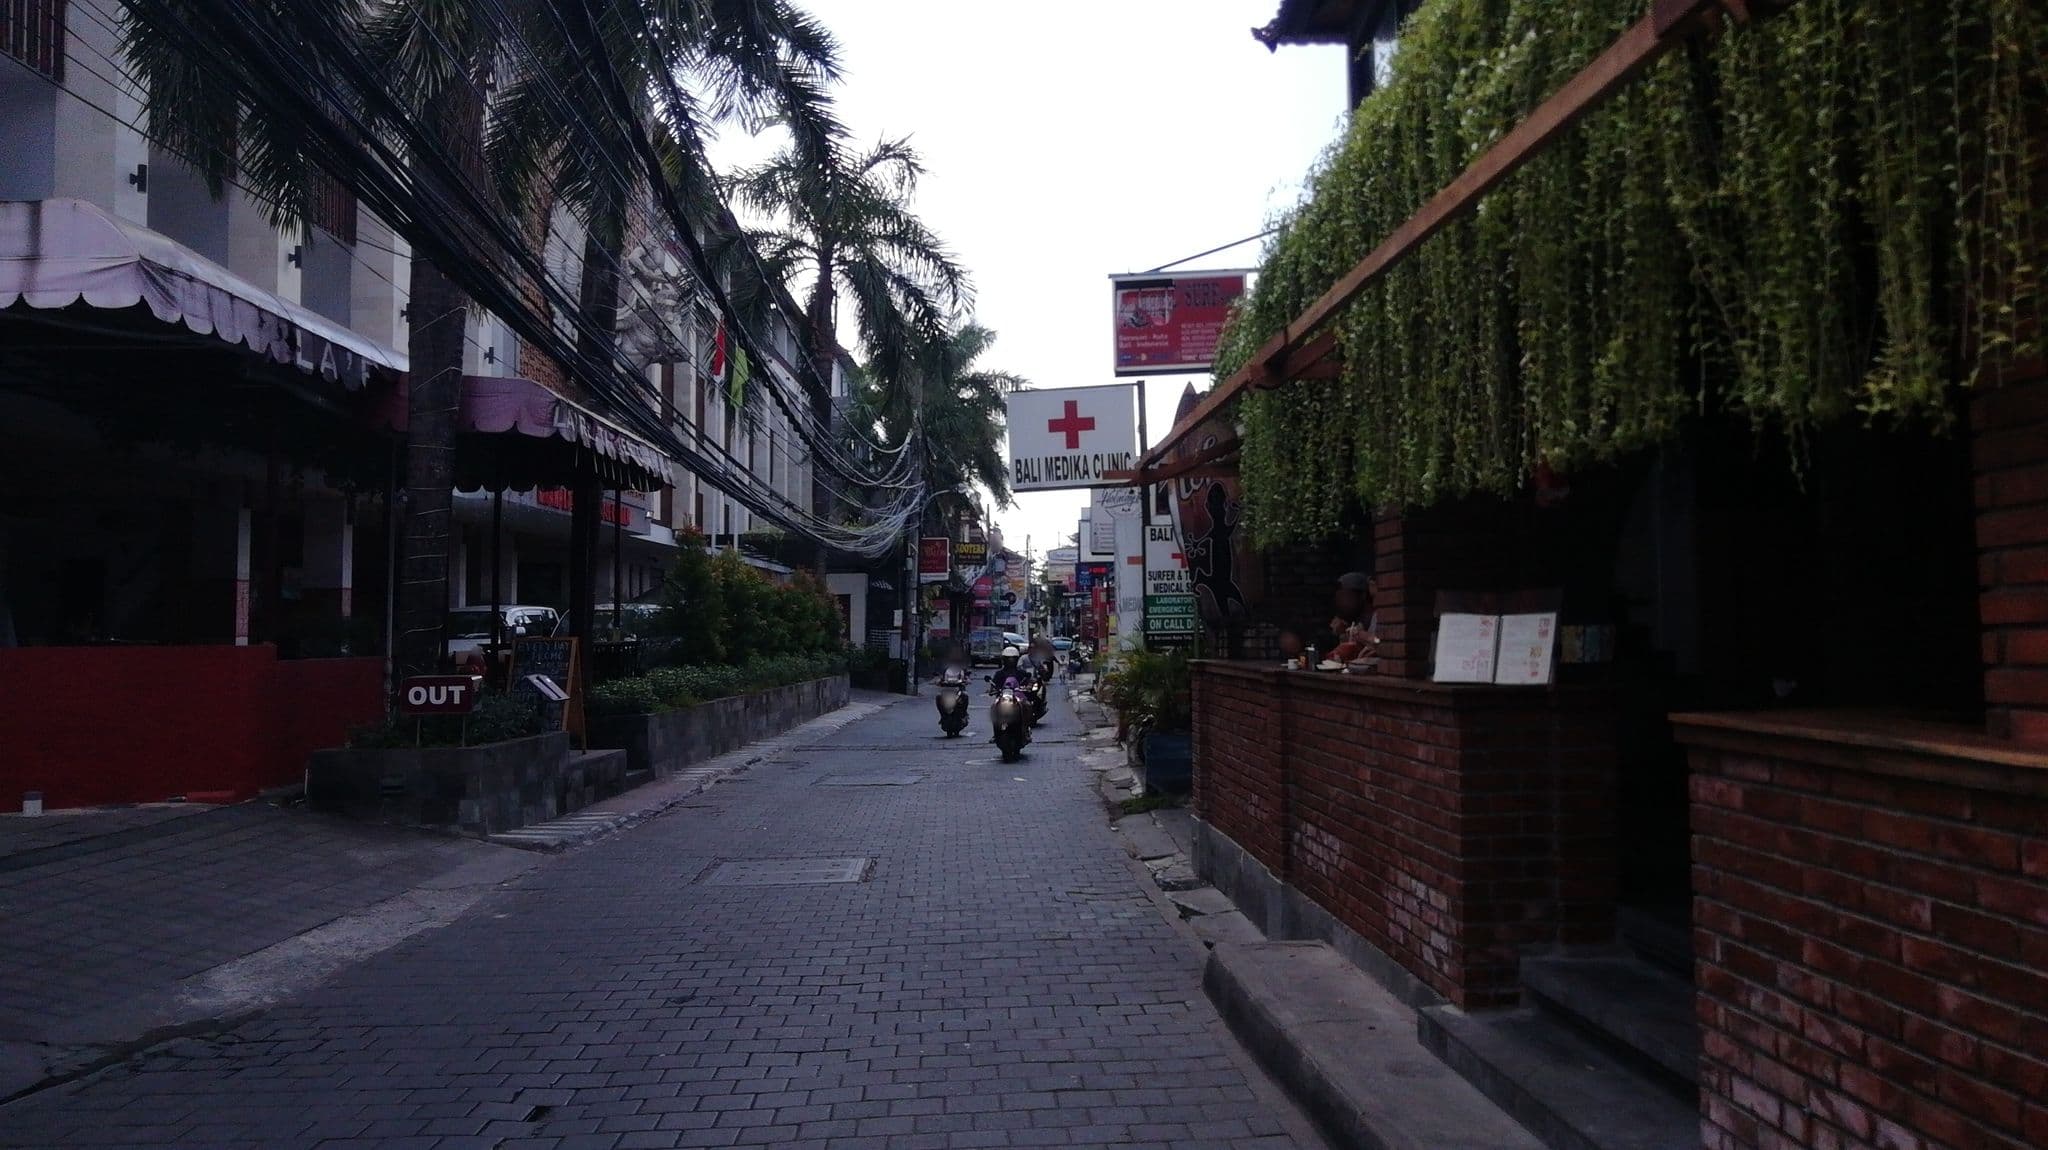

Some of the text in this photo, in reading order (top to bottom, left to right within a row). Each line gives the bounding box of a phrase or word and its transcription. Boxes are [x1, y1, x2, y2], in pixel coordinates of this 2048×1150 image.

[1015, 451, 1132, 484] BALI MEDIKA CLINIC
[1150, 527, 1173, 541] BALI
[1148, 570, 1175, 581] SURFER
[1153, 582, 1183, 593] MEDICAL
[1149, 618, 1162, 630] ON
[1163, 618, 1185, 629] CALL
[408, 685, 466, 706] OUT
